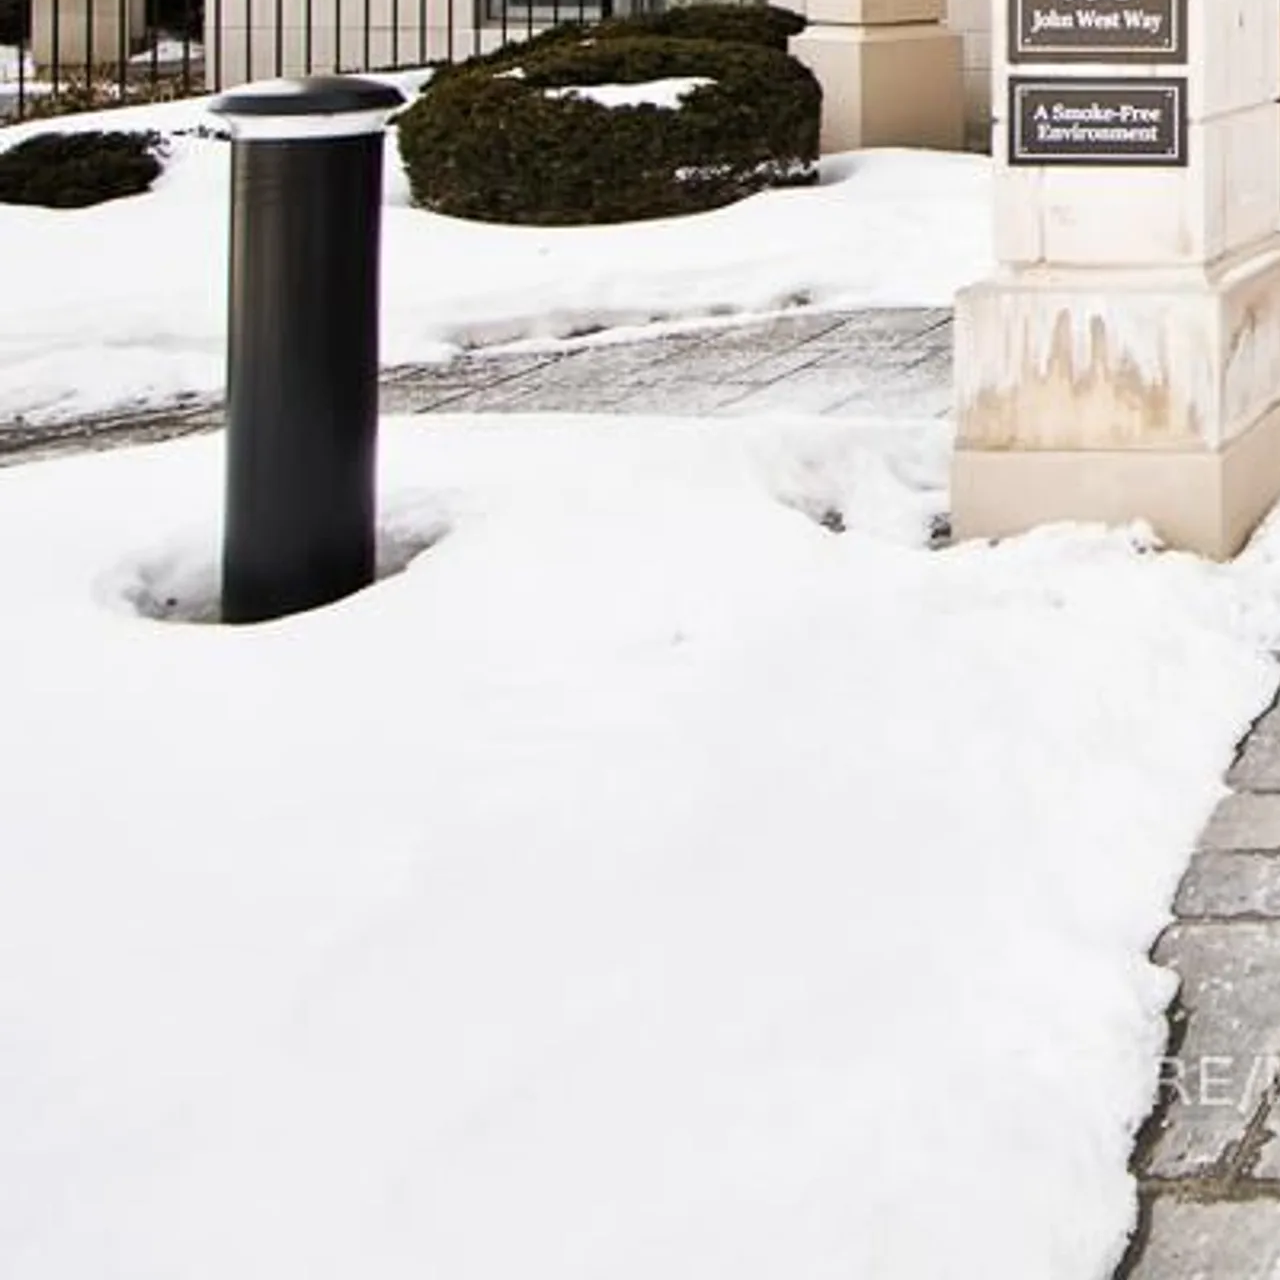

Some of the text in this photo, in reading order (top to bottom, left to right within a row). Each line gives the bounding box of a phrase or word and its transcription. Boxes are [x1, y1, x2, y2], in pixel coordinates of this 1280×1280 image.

[1030, 9, 1162, 34] John West Way
[1033, 102, 1161, 122] A Smoke-Free
[1037, 122, 1158, 142] Environment
